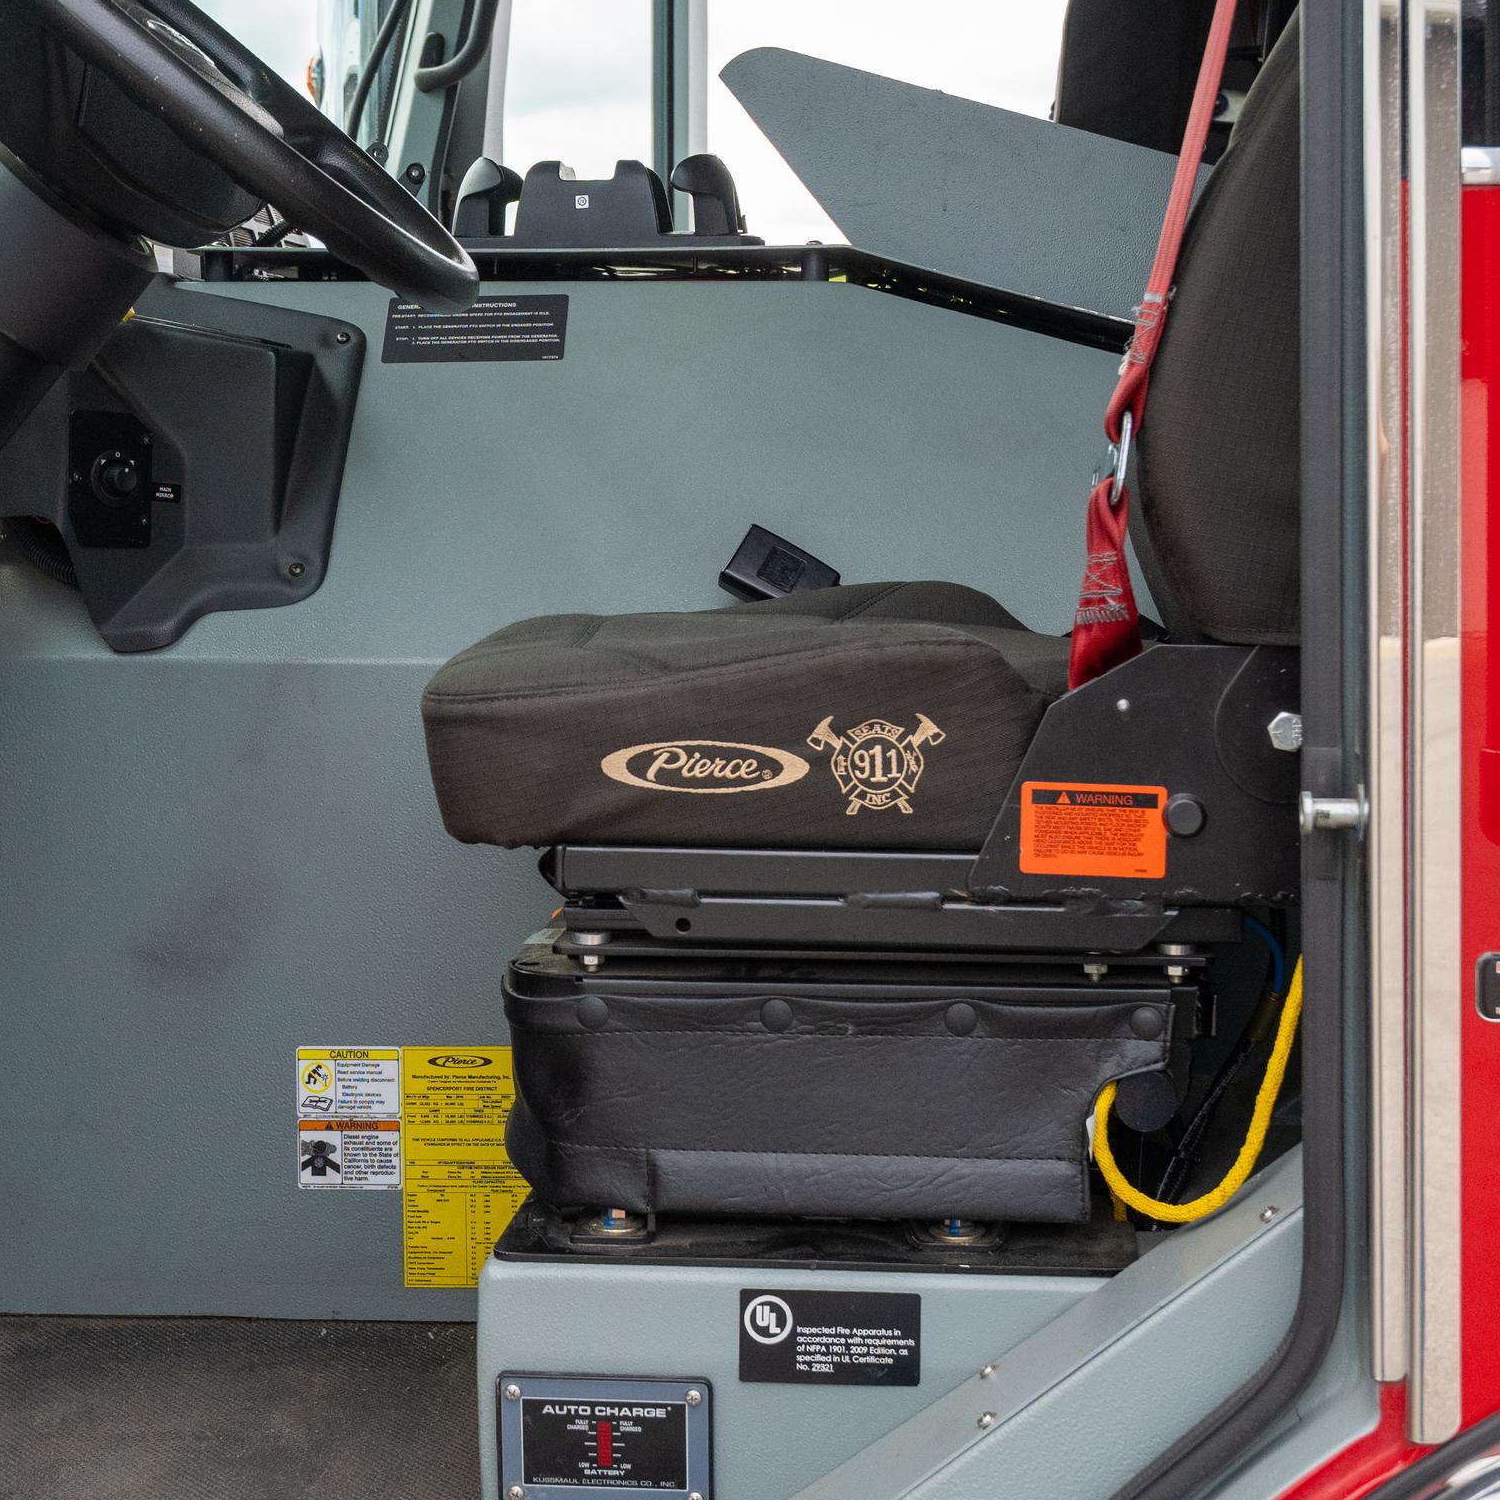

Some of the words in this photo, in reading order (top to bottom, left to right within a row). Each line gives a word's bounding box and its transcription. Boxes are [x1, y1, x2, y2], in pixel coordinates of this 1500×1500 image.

[854, 724, 898, 737] SEATS
[646, 746, 762, 783] Pierce
[854, 745, 902, 783] 911
[865, 793, 892, 805] INC
[1075, 793, 1133, 805] WARNING
[329, 1051, 369, 1059] CAUTION
[443, 1056, 477, 1067] Pierce
[336, 1122, 379, 1130] WARNING
[755, 1305, 781, 1334] UL
[796, 1326, 836, 1336] Inspected
[837, 1326, 851, 1335] Fire
[852, 1327, 892, 1338] Apparatus
[893, 1328, 901, 1336] in
[796, 1336, 846, 1344] accordance
[846, 1337, 863, 1345] with
[864, 1338, 915, 1348] requirements
[796, 1344, 805, 1352] of
[806, 1345, 827, 1353] NFPA
[850, 1346, 868, 1354] 2009
[796, 1354, 832, 1364] specified
[833, 1355, 840, 1363] in
[841, 1355, 851, 1363] UL
[852, 1355, 894, 1365] Certificate
[796, 1363, 810, 1371] No.
[541, 1404, 591, 1415] AUTO
[594, 1405, 668, 1418] CHARGE
[532, 1476, 580, 1485] KUSSMAUL
[581, 1478, 639, 1487] ELECTRONICS
